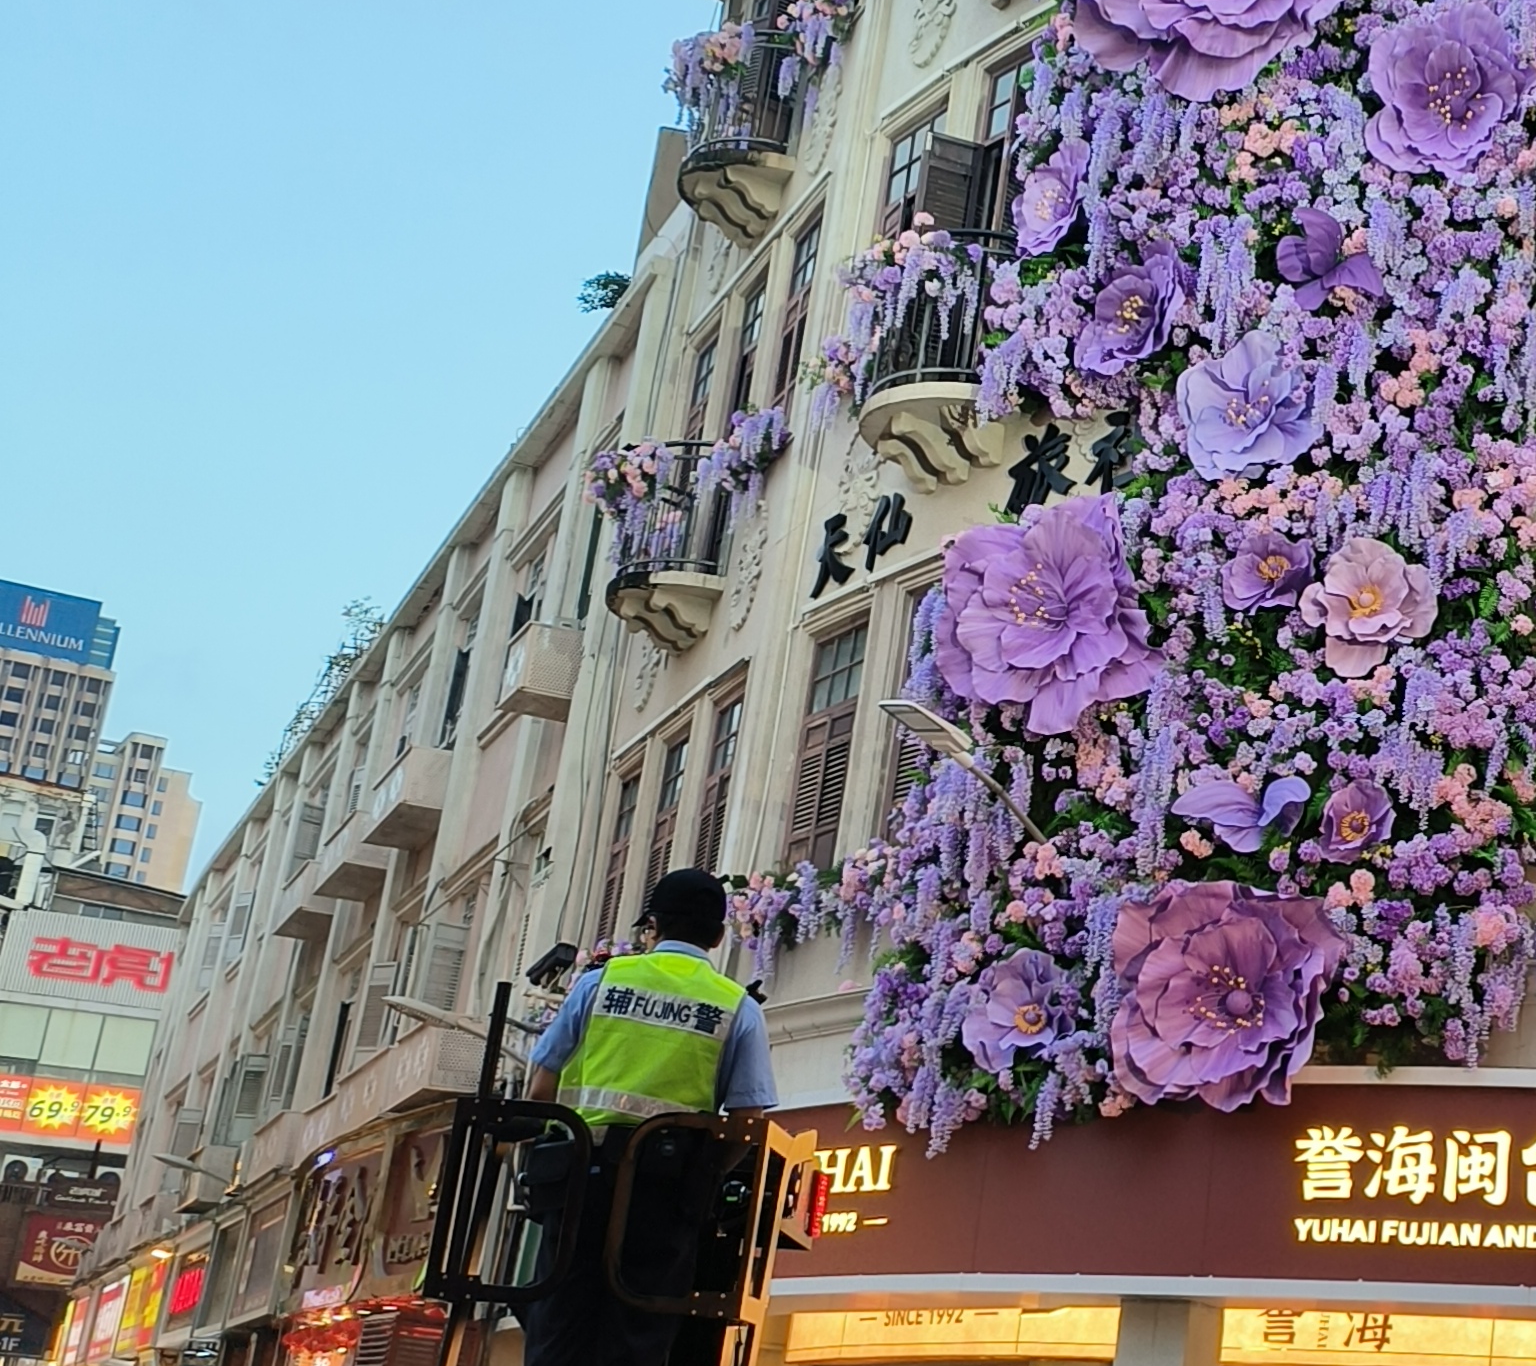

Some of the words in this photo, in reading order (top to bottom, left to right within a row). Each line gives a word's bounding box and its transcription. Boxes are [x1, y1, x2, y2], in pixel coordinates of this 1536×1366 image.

[603, 986, 635, 1015] 辅
[632, 996, 691, 1023] FUJING
[693, 1002, 725, 1034] 警
[1294, 1218, 1377, 1243] YUHAI
[1381, 1220, 1482, 1247] FUJIAN
[884, 1309, 924, 1326] SINCE
[929, 1308, 964, 1325] 1992
